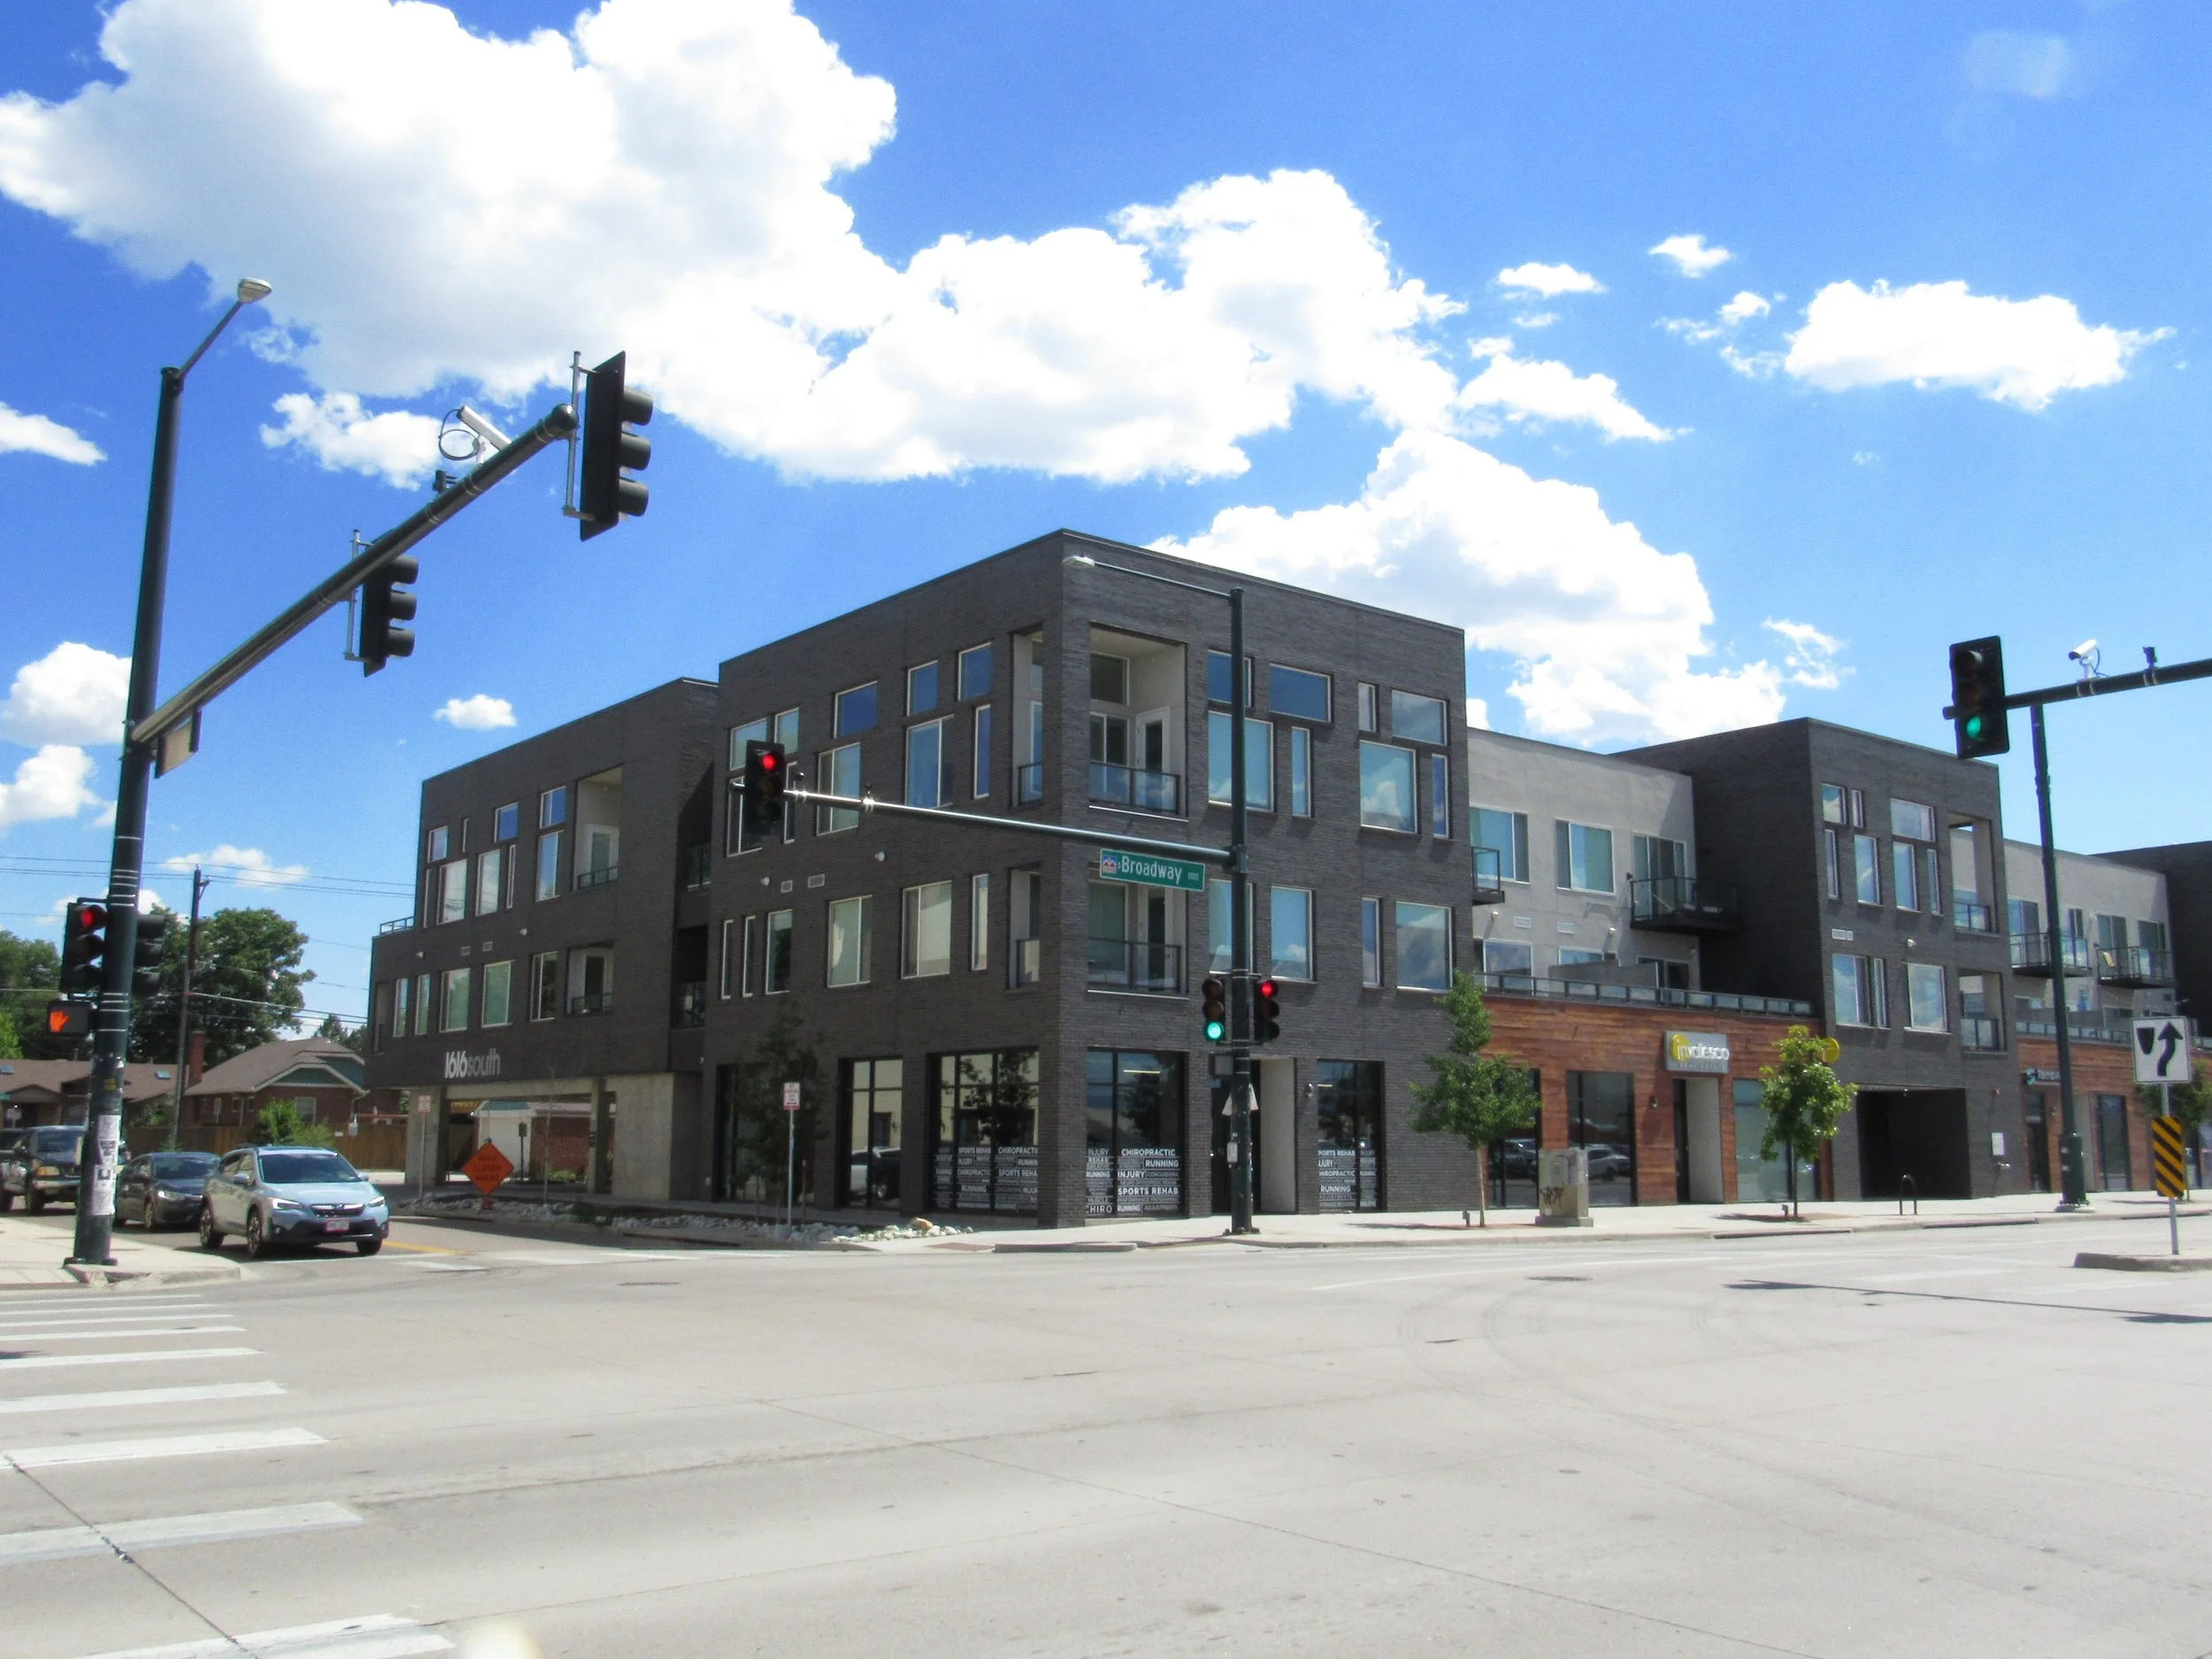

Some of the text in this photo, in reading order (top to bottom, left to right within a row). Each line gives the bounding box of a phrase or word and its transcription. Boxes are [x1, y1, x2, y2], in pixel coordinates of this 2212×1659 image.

[1121, 856, 1182, 885] Broadway
[444, 1048, 501, 1079] 1616south
[1145, 1159, 1179, 1168] RUNNING
[1320, 1185, 1351, 1194] RUNNING
